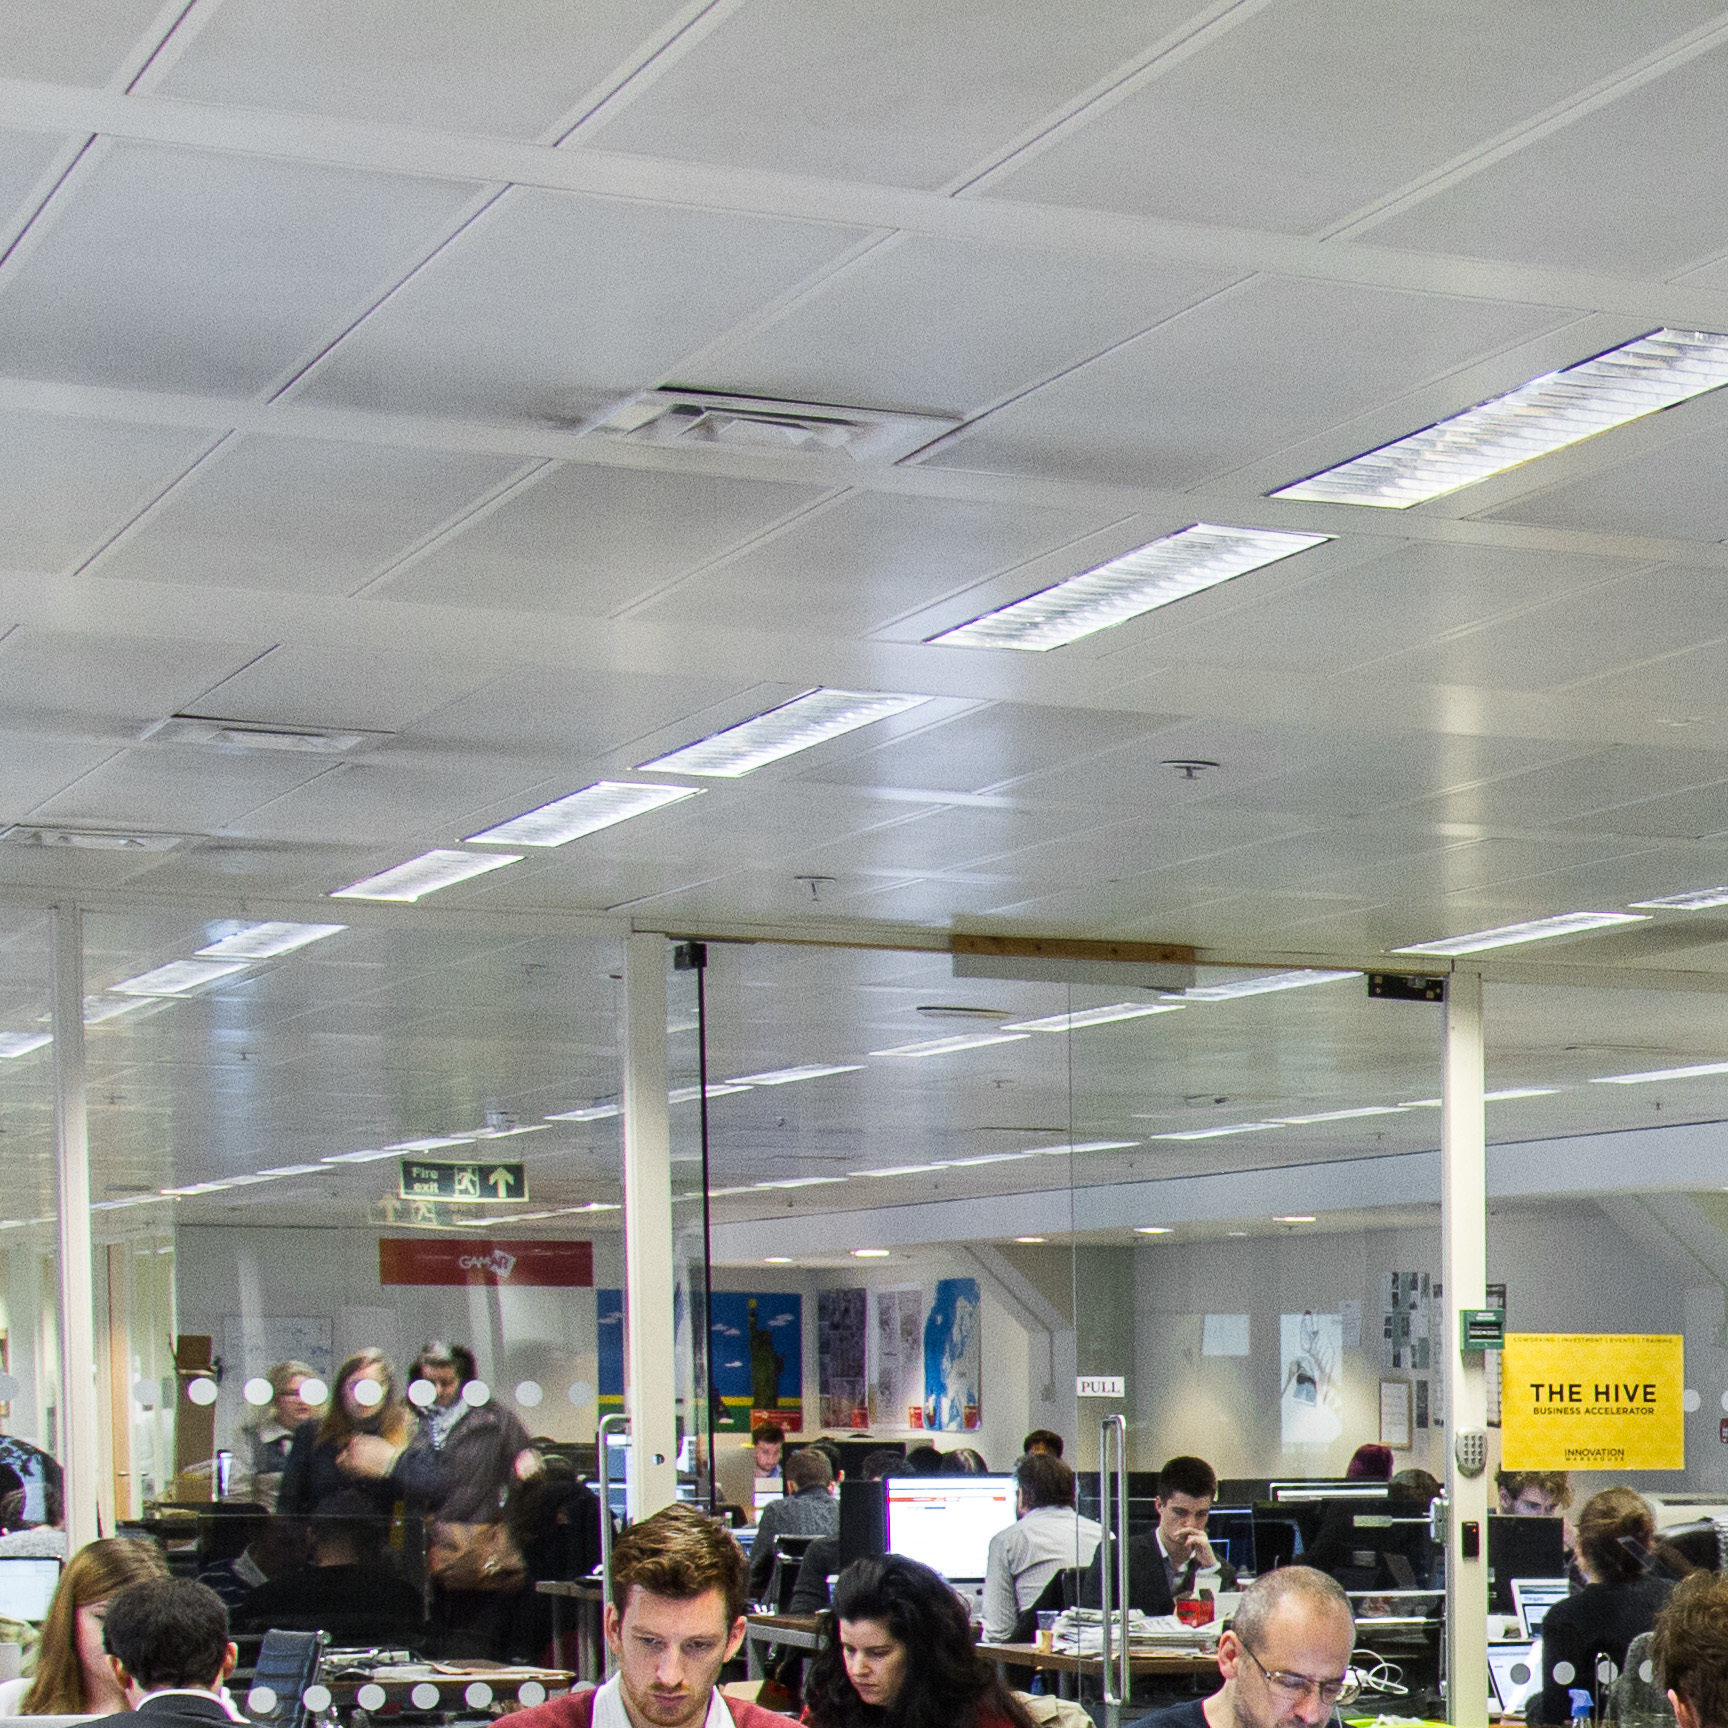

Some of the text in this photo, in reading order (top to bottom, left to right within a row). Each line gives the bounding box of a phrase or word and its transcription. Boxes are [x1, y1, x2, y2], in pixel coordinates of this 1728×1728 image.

[412, 1167, 438, 1179] Fire
[413, 1182, 439, 1193] exit
[1082, 1381, 1120, 1393] PULL
[1530, 1384, 1657, 1402] THE HIVE
[1533, 1407, 1655, 1415] BUSINESS ACCELERATOR
[1564, 1448, 1625, 1456] INNOVATION
